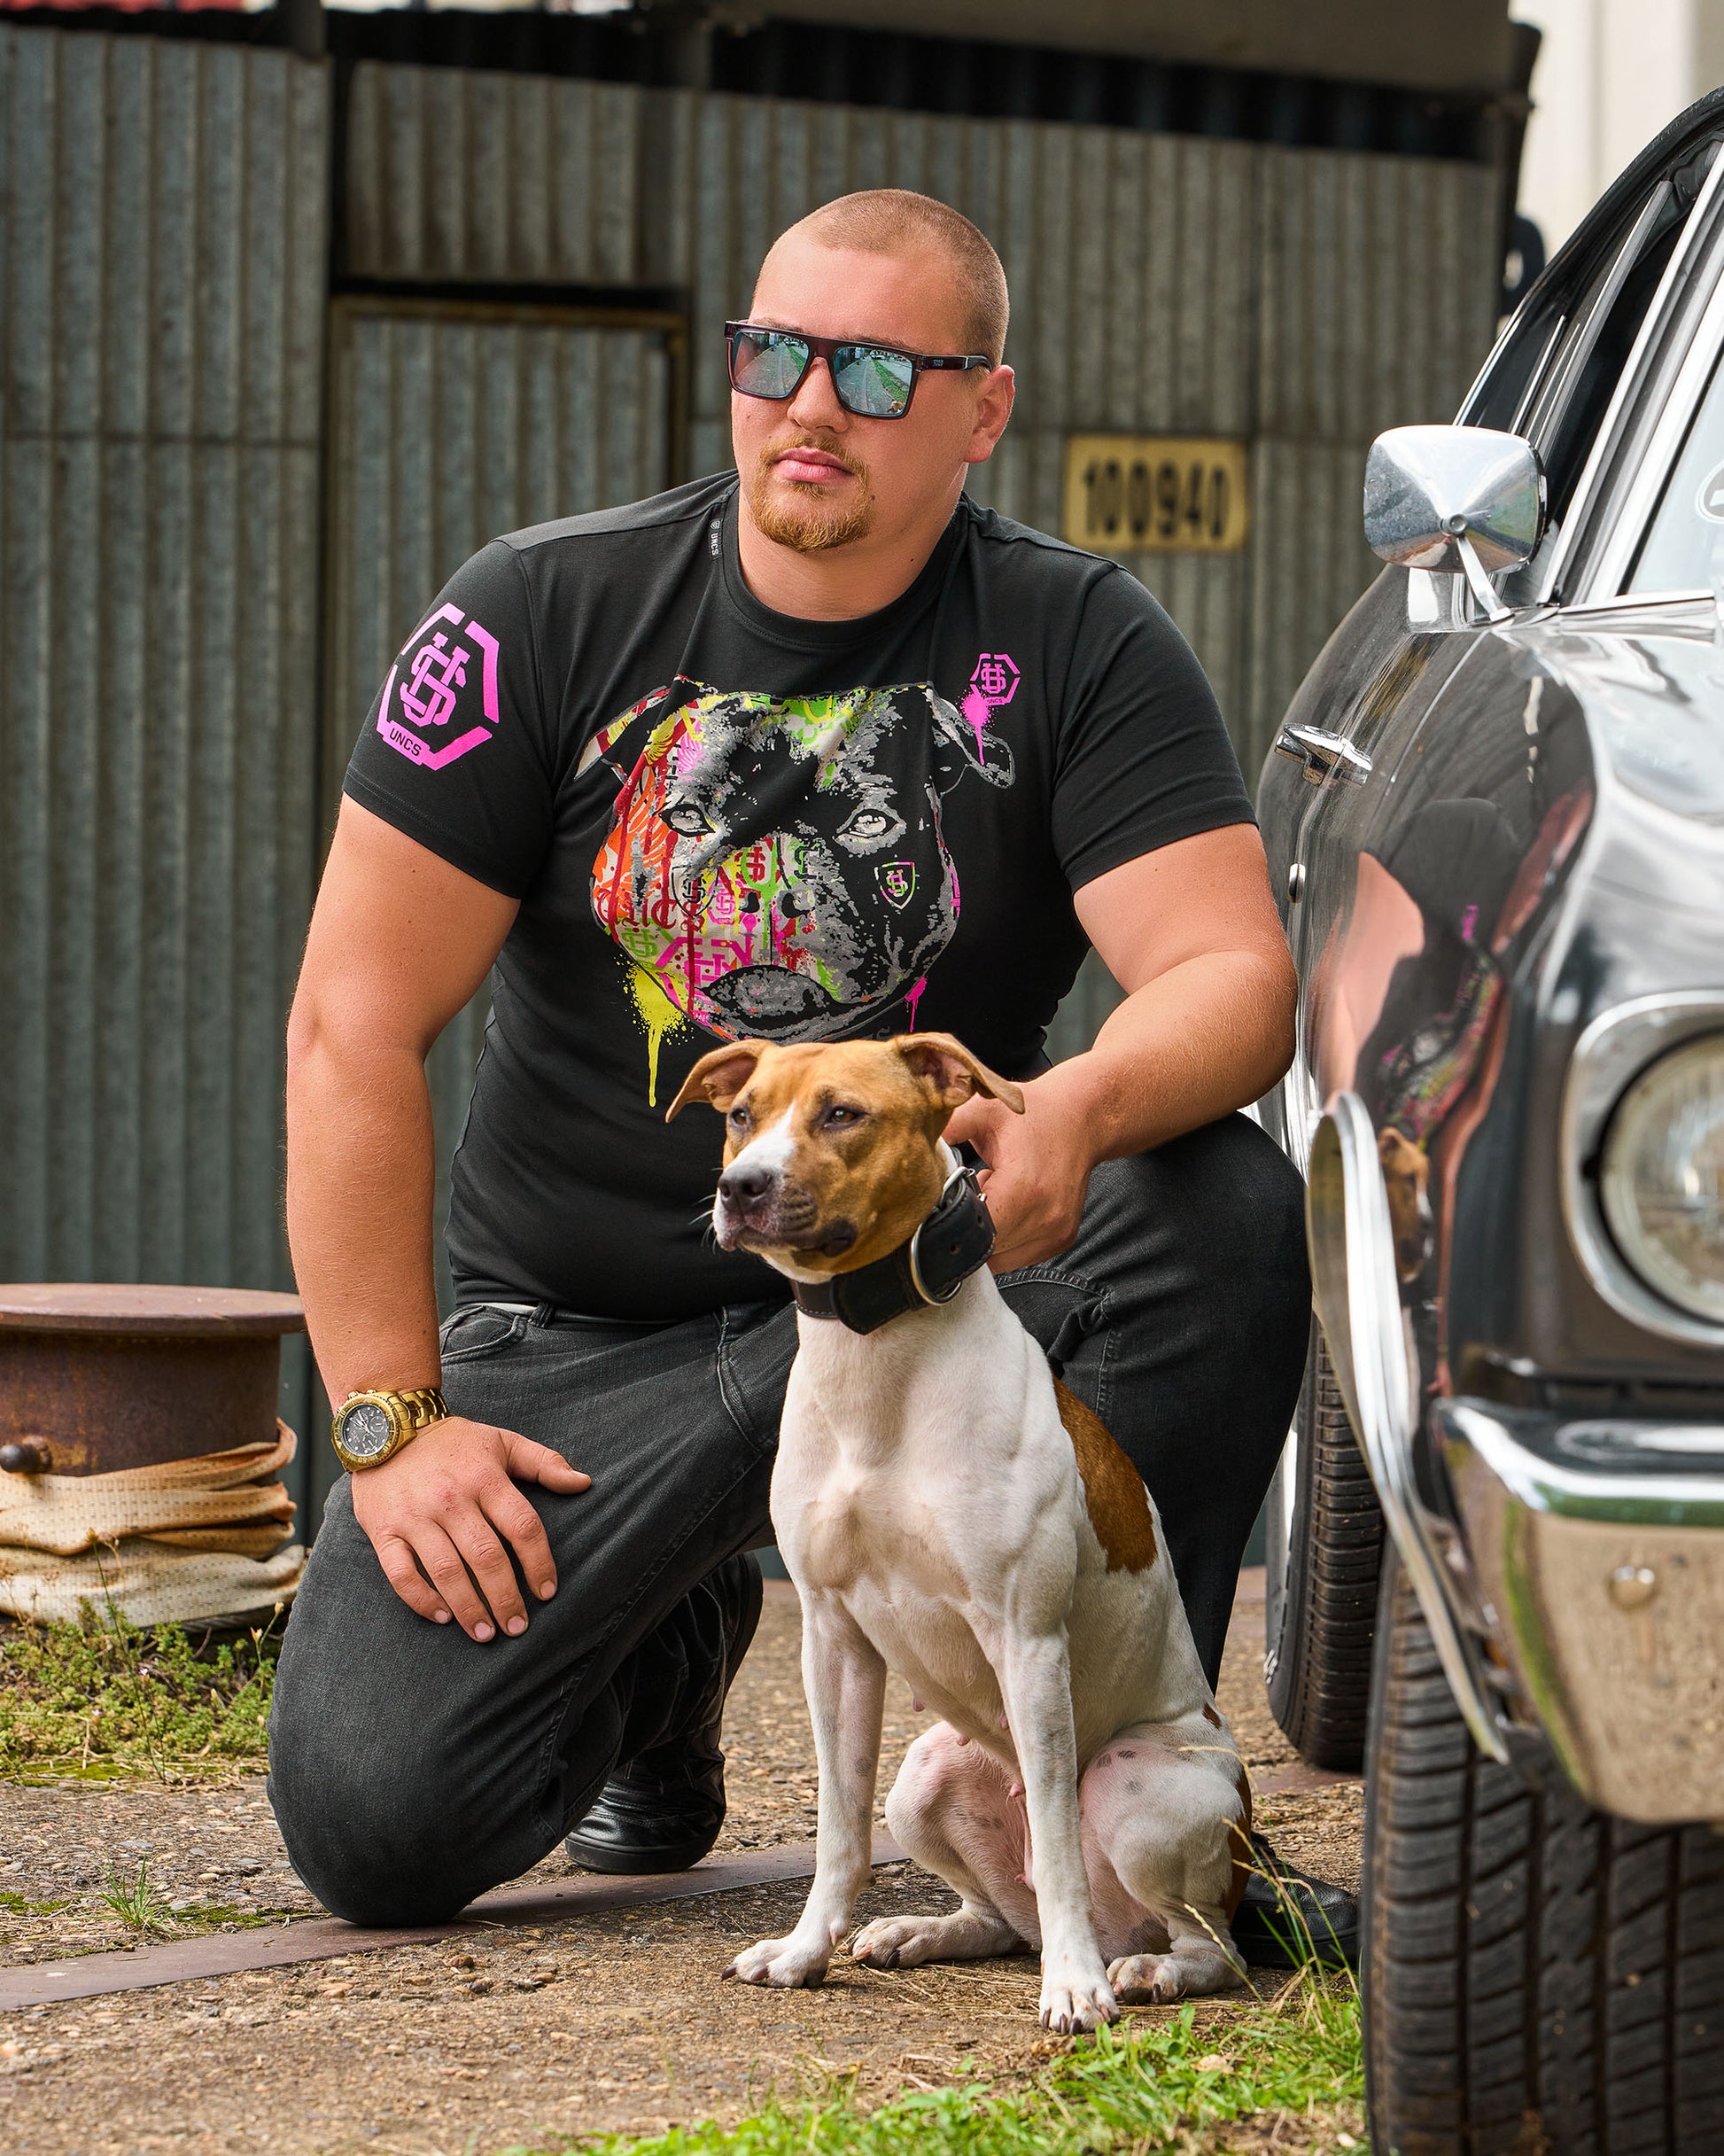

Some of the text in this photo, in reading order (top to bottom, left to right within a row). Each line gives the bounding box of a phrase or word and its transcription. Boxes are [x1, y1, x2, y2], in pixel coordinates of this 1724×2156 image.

[1083, 458, 1229, 540] 100940
[711, 533, 719, 556] UNCS
[390, 728, 422, 756] UNCS
